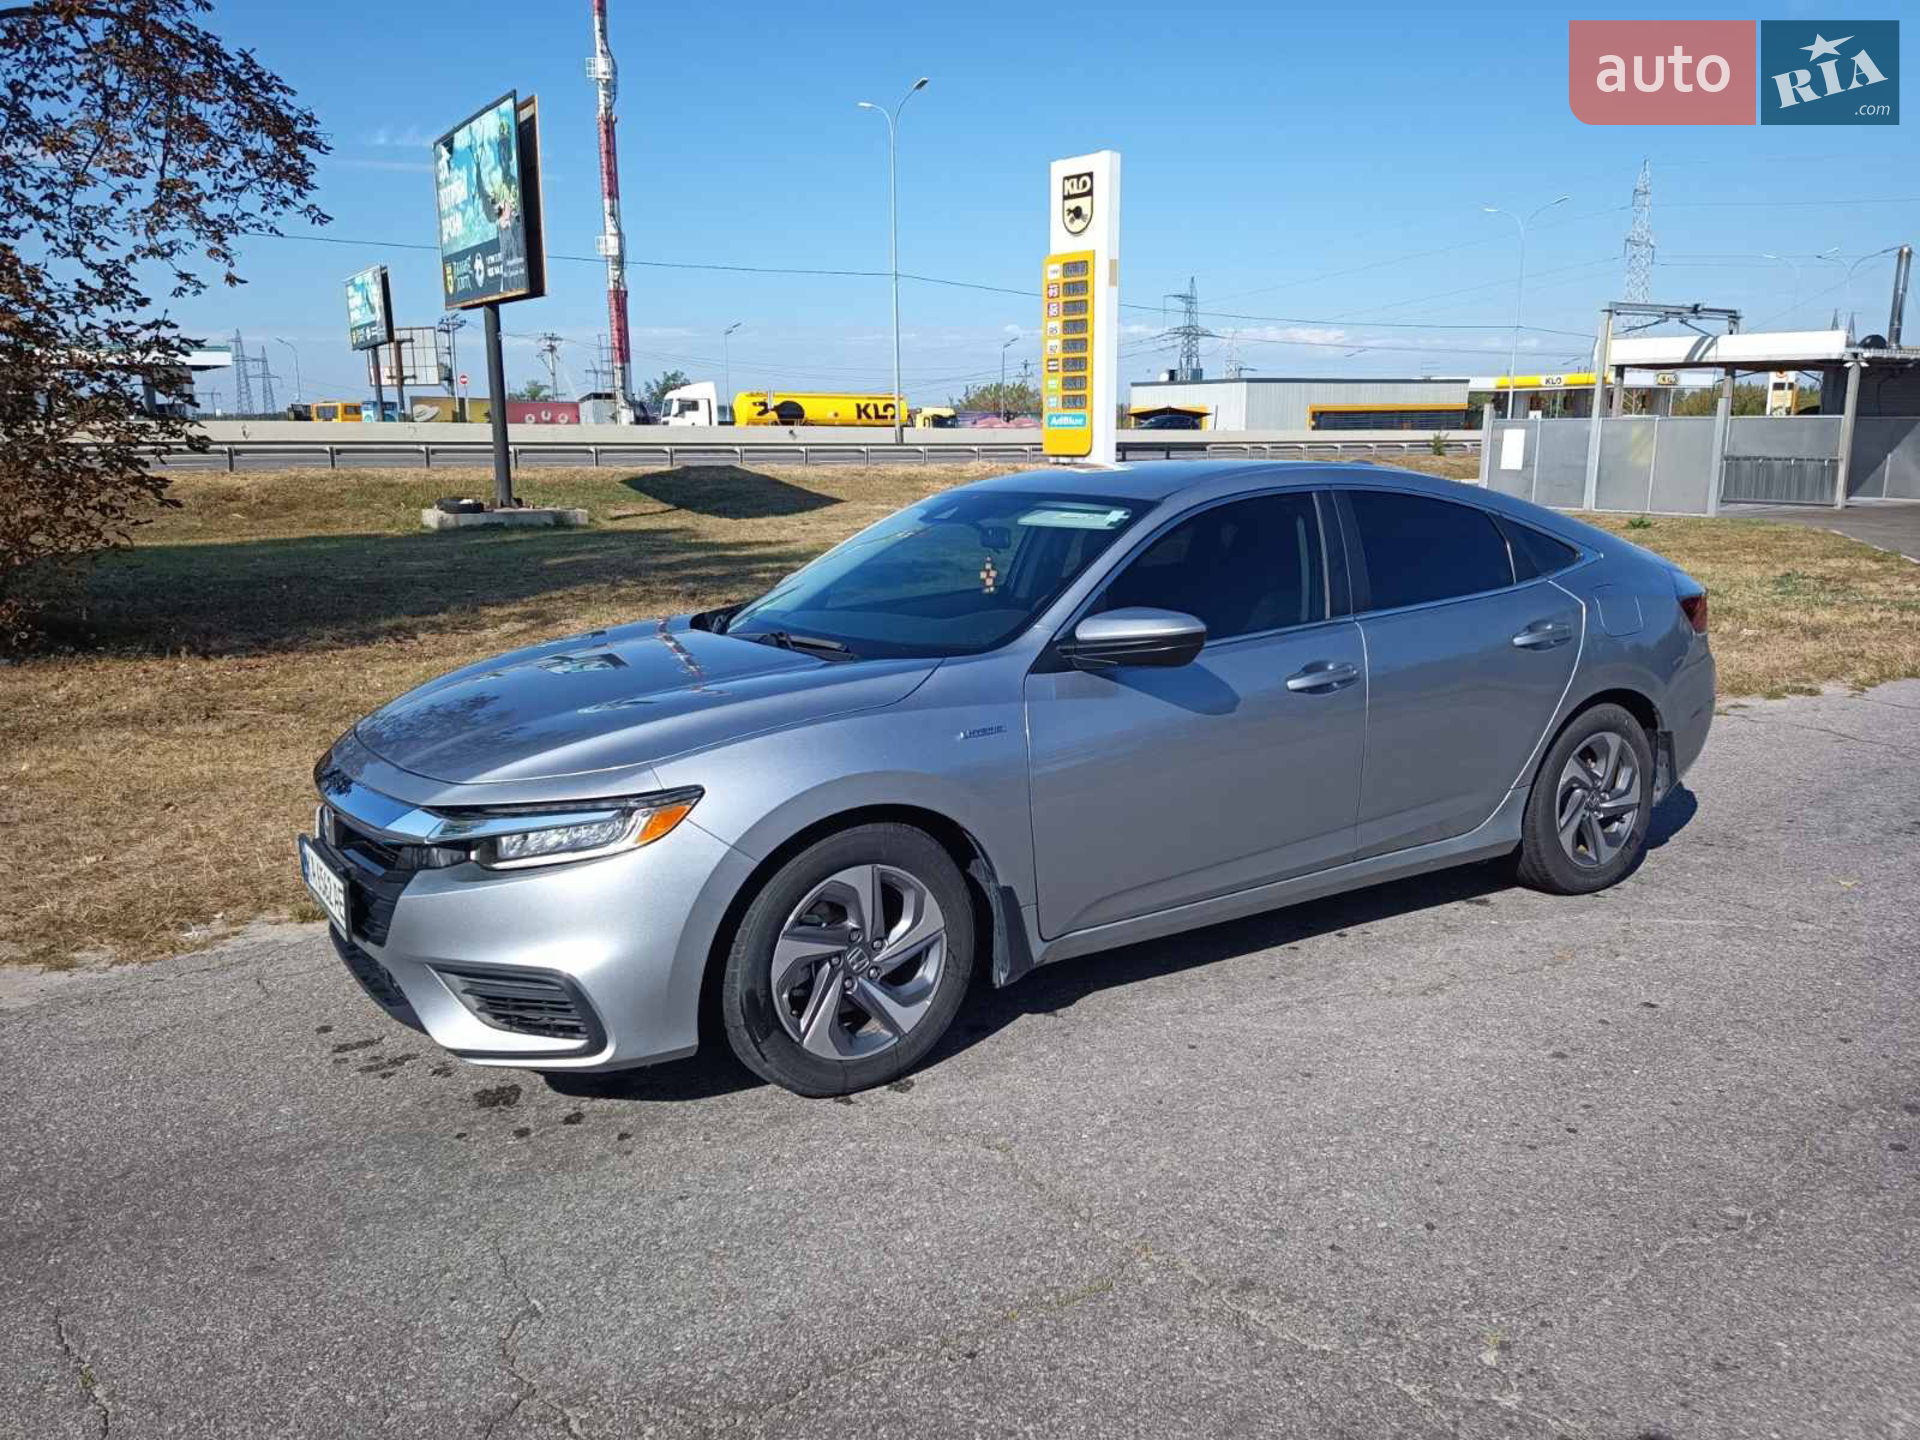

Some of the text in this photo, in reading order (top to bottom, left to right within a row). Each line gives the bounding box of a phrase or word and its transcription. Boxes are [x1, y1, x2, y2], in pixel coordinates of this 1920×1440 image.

[1064, 176, 1091, 196] KLO
[1545, 376, 1562, 385] KLO
[855, 402, 898, 420] KLO
